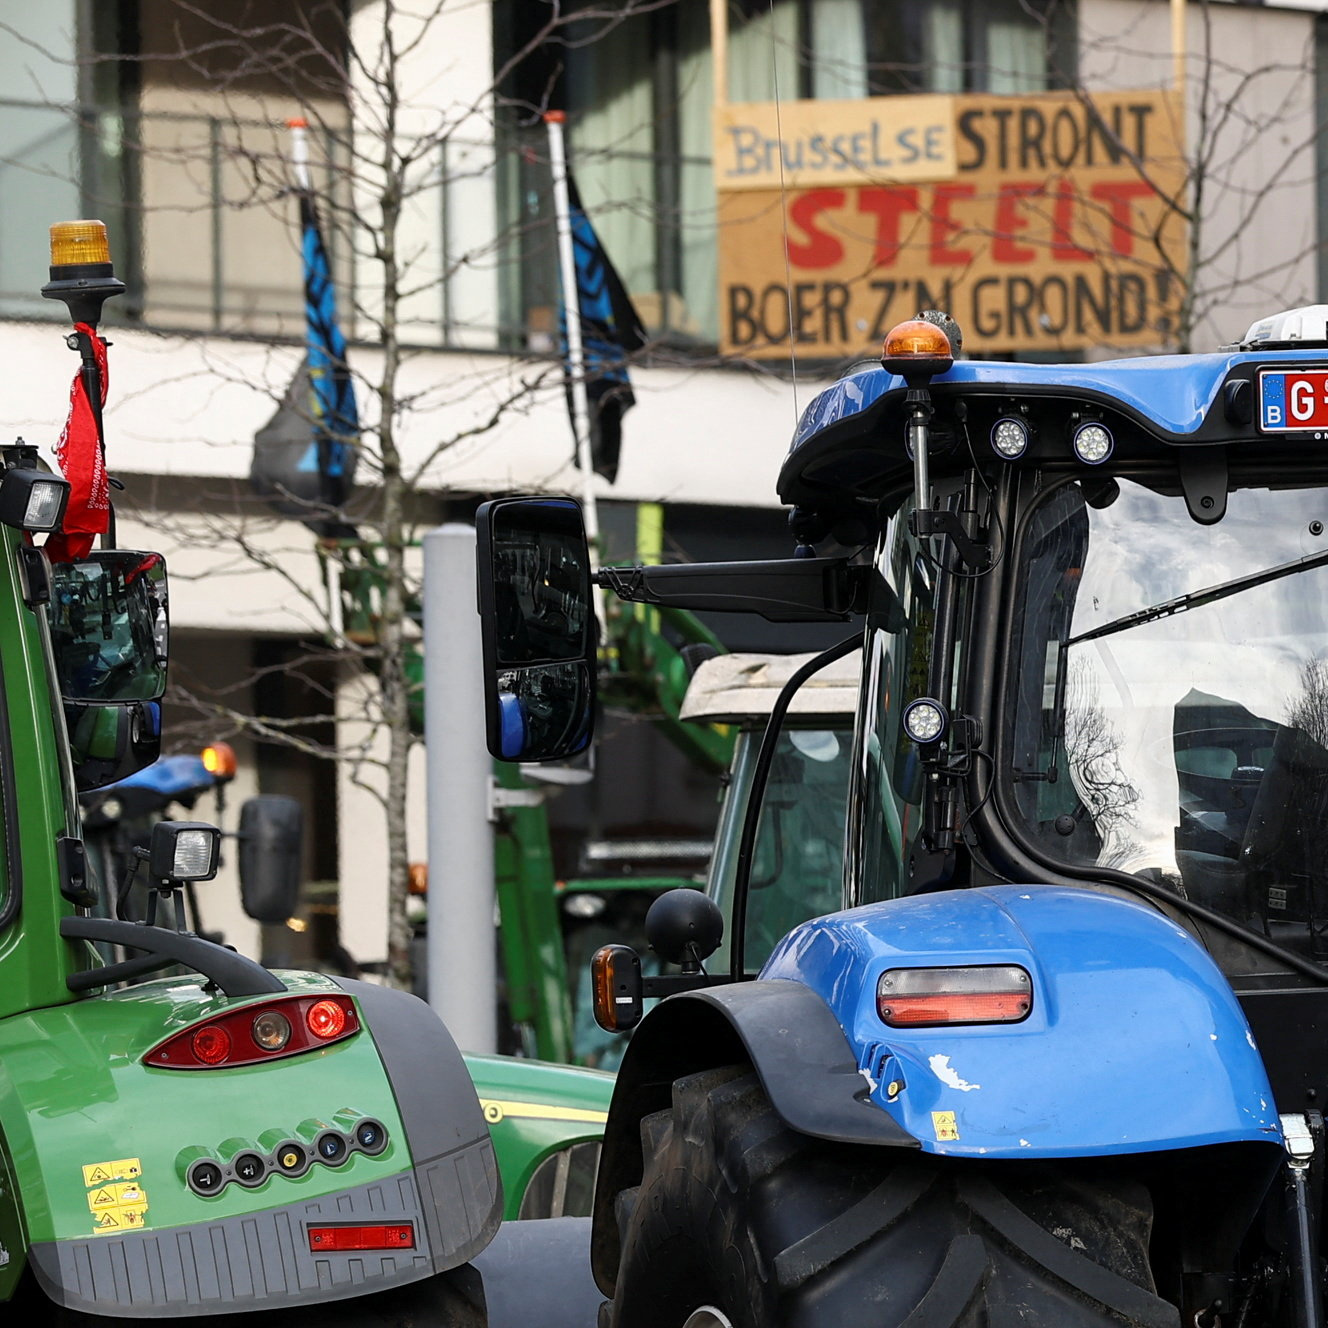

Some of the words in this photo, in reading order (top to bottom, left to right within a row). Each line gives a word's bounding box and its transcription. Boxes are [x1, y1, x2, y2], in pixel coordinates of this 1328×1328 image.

[957, 105, 1154, 172] STRONT
[783, 179, 1162, 270] STEELT
[727, 280, 853, 346] BOER
[971, 270, 1171, 338] GROND!
[1267, 405, 1282, 424] B
